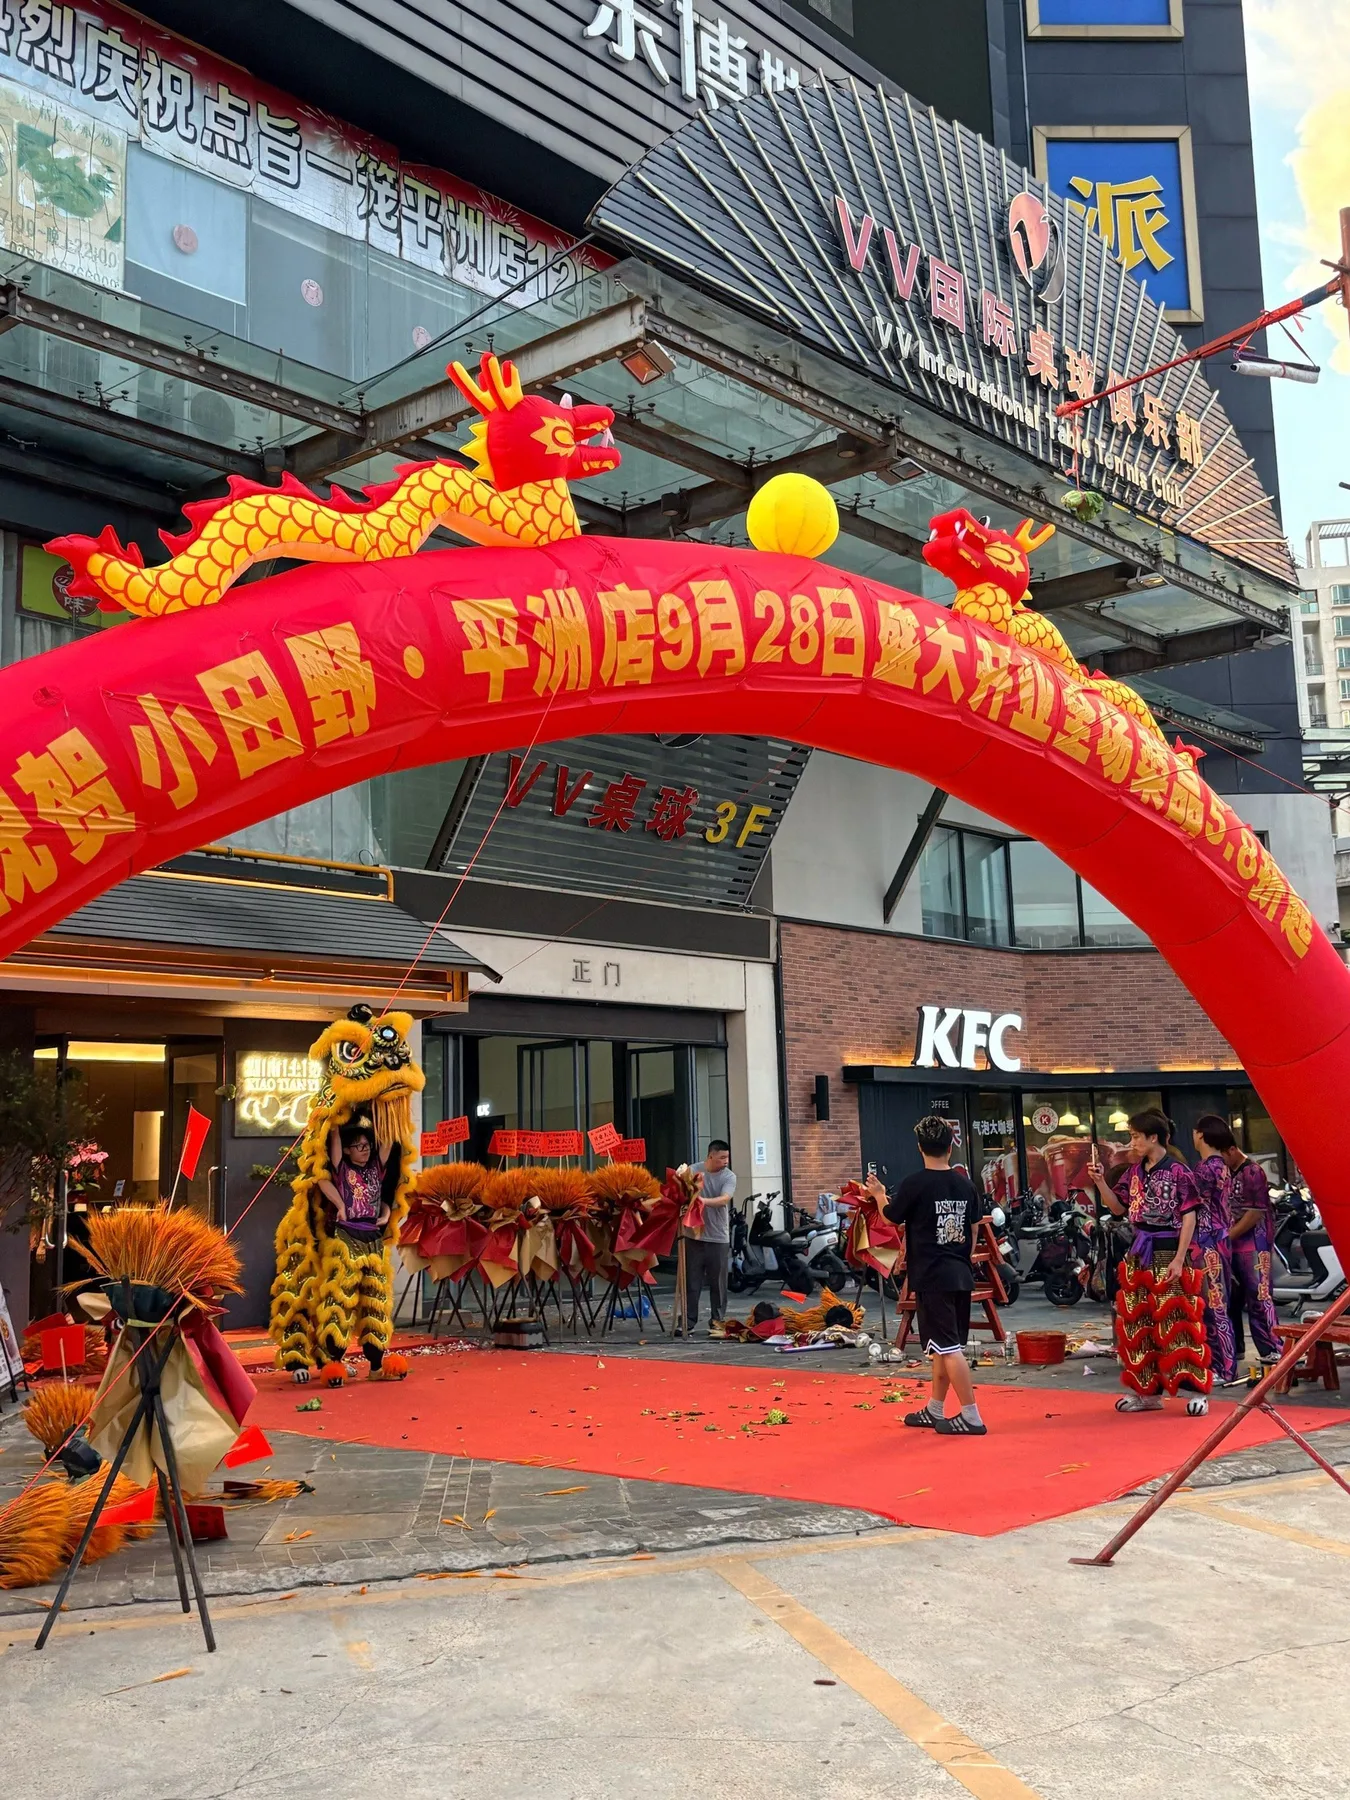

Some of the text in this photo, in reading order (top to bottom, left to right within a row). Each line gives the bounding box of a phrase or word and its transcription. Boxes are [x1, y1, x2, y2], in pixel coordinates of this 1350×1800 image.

[1069, 175, 1175, 272] 派
[1094, 437, 1148, 490] Tennis
[1151, 472, 1184, 509] Club
[572, 958, 620, 987] 正门
[915, 1005, 1022, 1072] KFC
